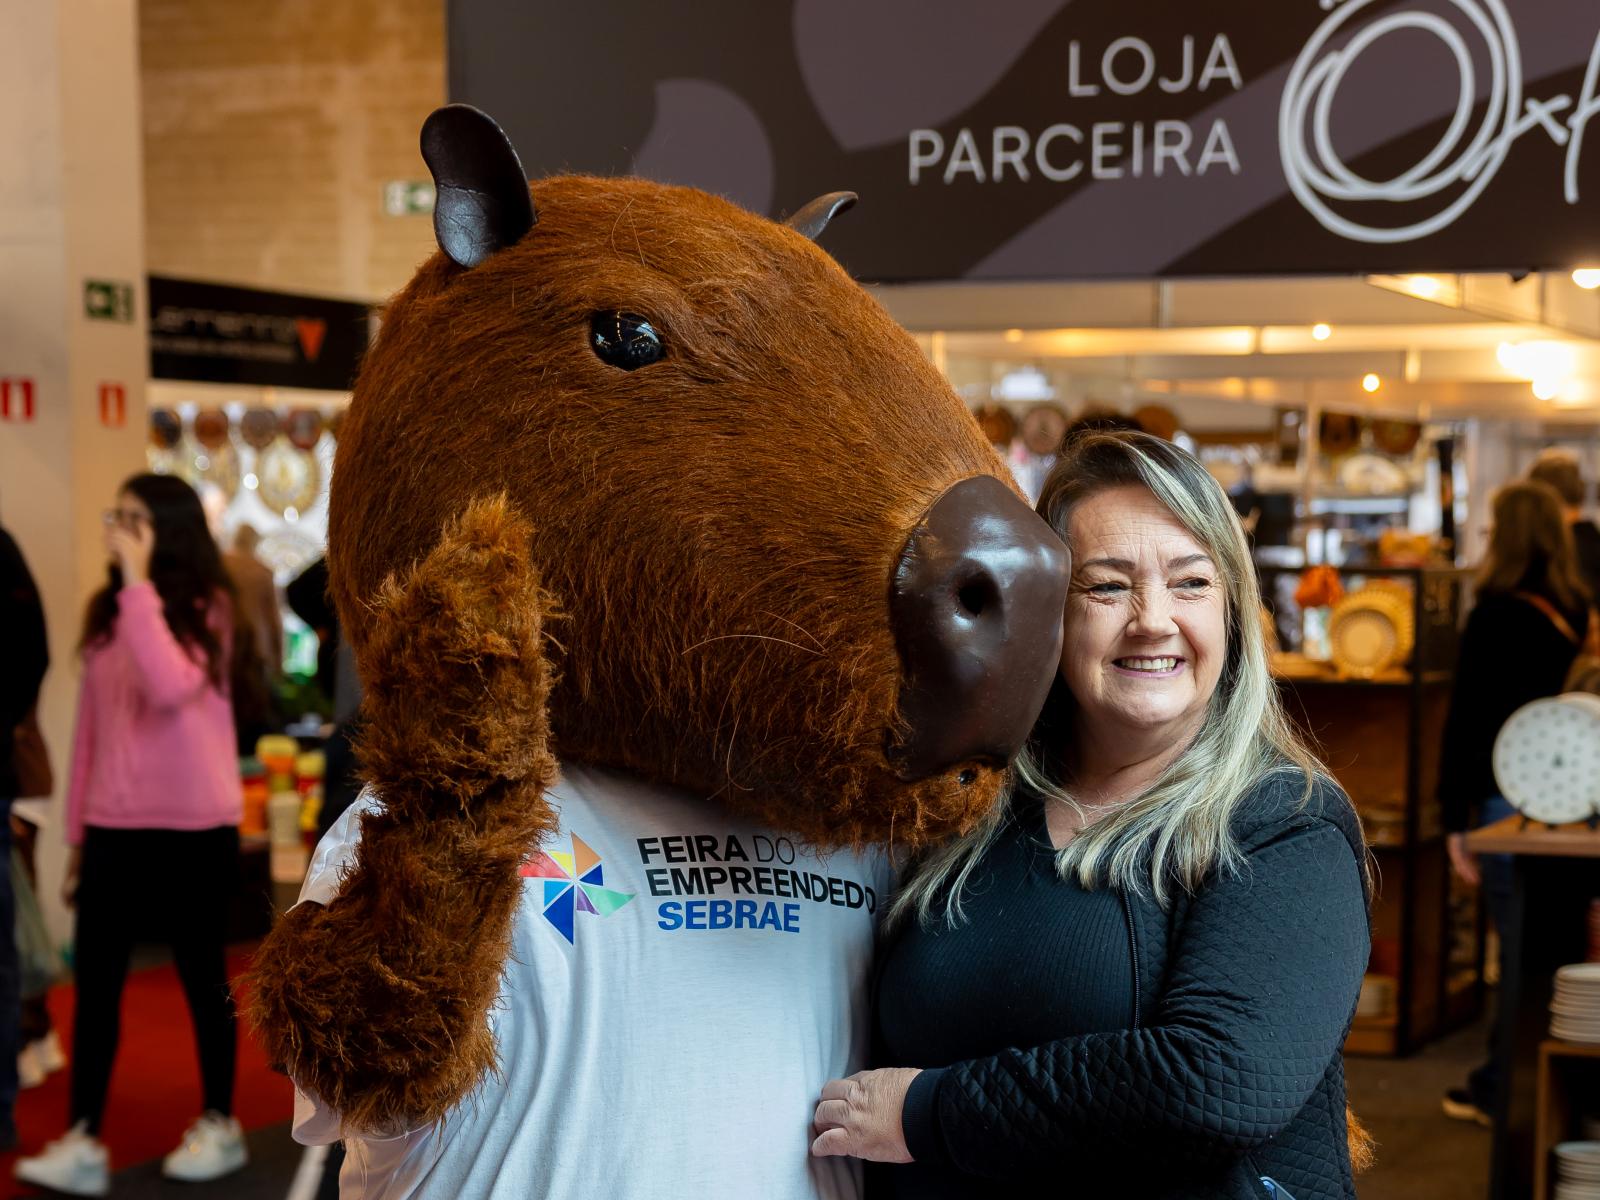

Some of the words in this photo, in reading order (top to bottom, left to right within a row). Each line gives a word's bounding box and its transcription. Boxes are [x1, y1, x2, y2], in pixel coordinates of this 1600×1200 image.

[1068, 32, 1243, 98] LOJA
[908, 117, 1242, 186] PARCEIRA
[636, 834, 749, 865] FEIRA
[752, 835, 796, 866] DO
[657, 899, 801, 934] SEBRAE
